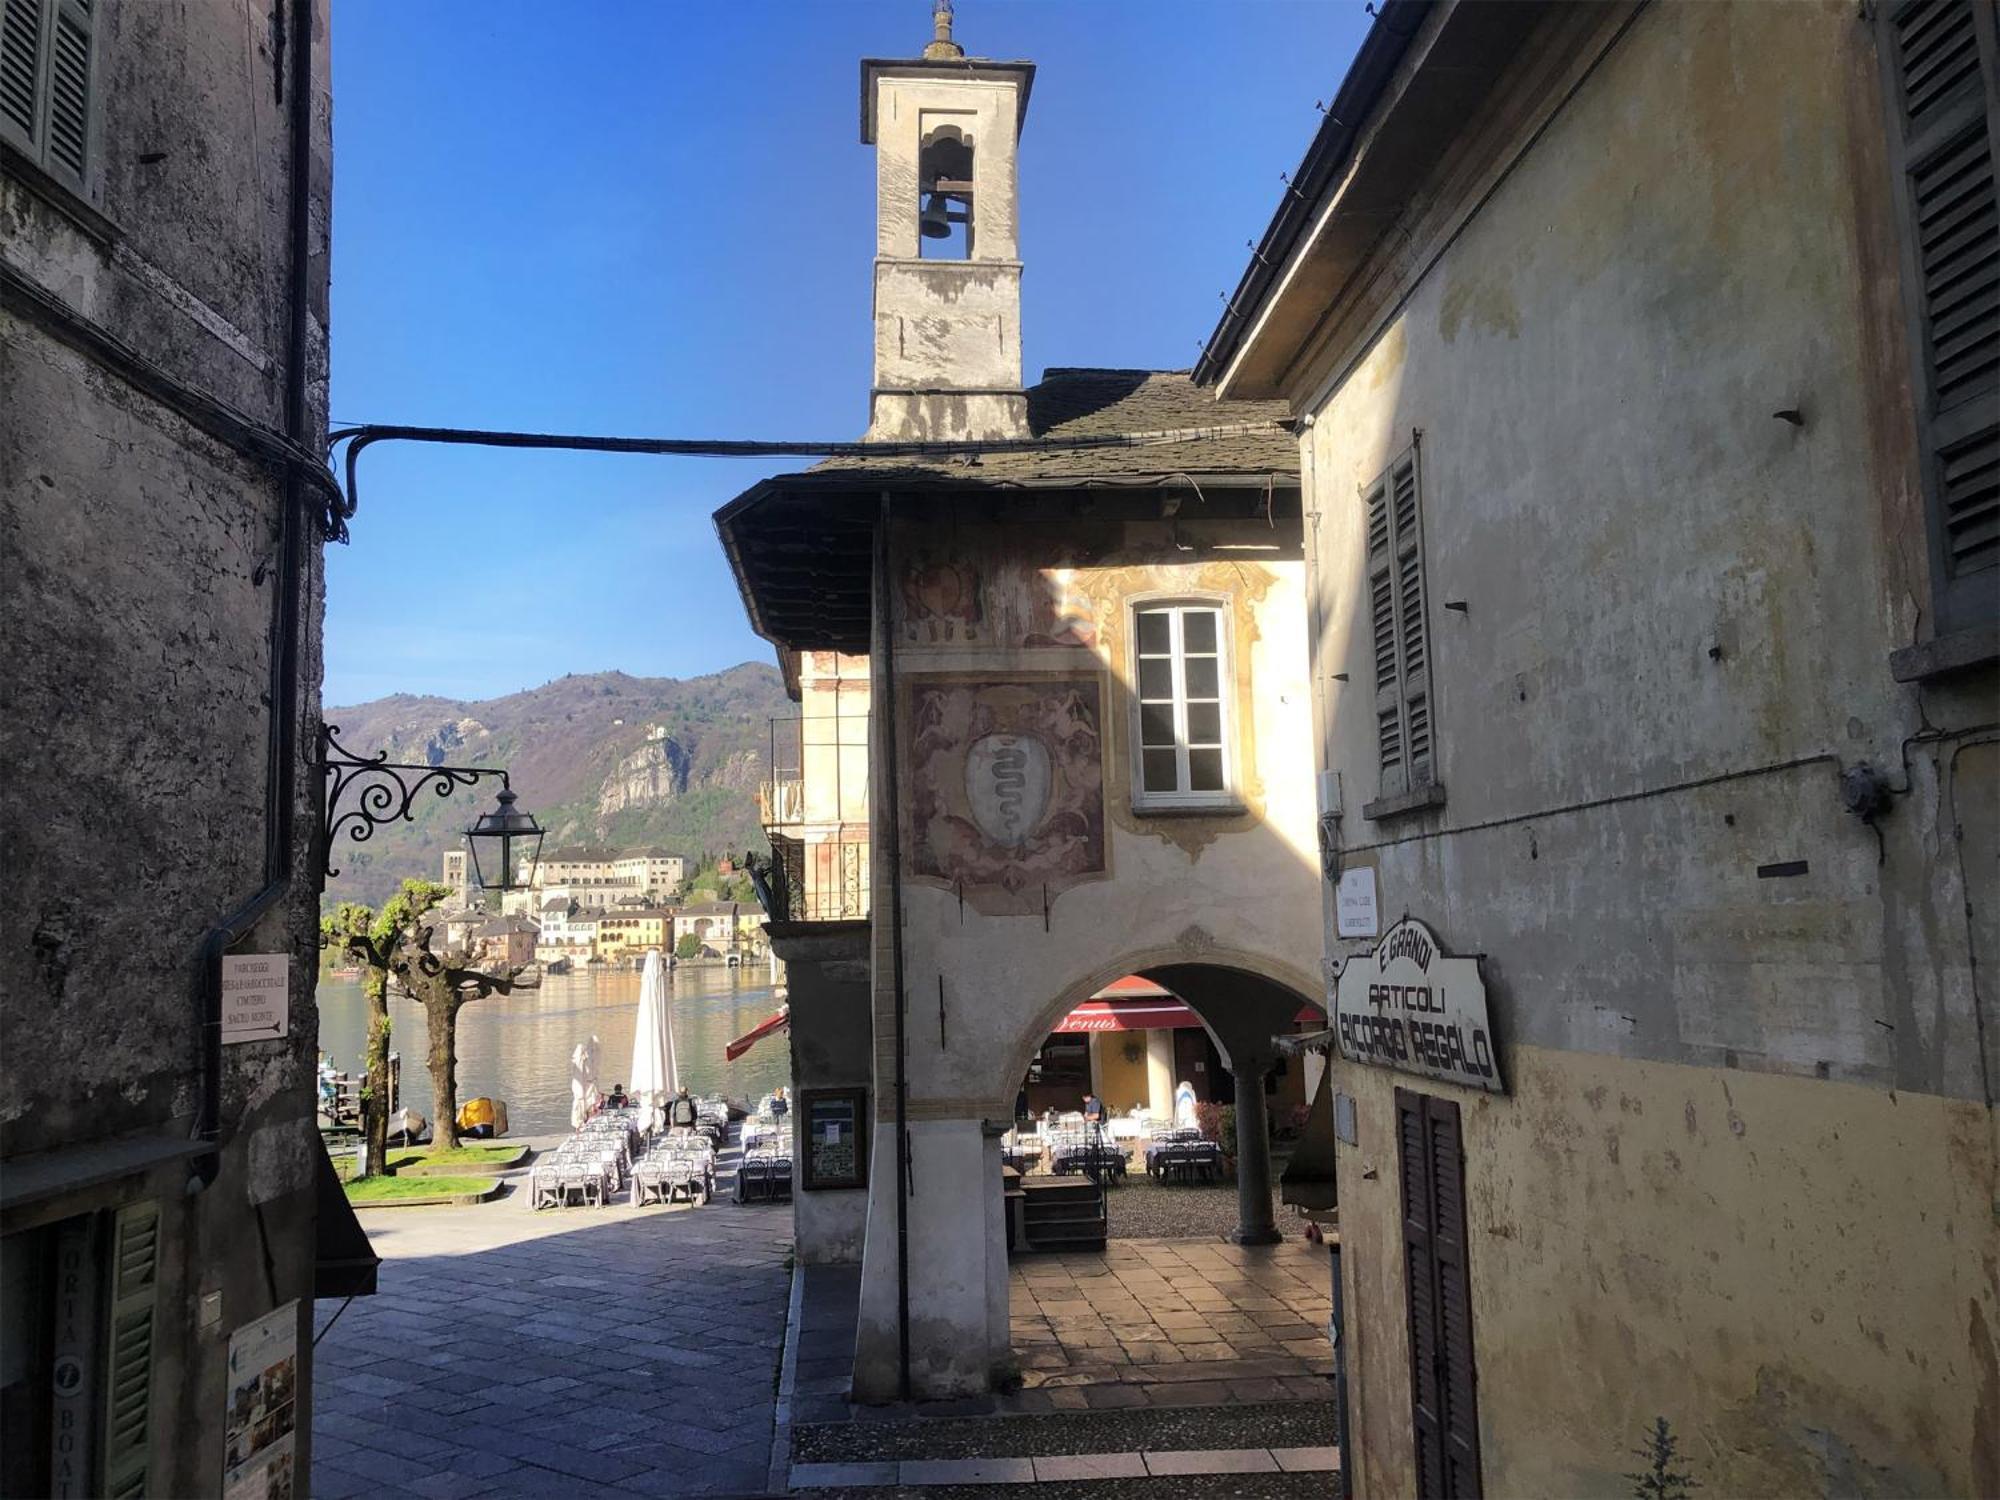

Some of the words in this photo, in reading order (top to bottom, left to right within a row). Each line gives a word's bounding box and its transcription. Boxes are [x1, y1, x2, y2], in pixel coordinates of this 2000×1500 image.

[1389, 927, 1432, 975] GRANDI
[1368, 984, 1446, 1014] ARTICOLI
[1339, 1012, 1408, 1061] RICORDO
[1409, 1020, 1493, 1078] REGALO
